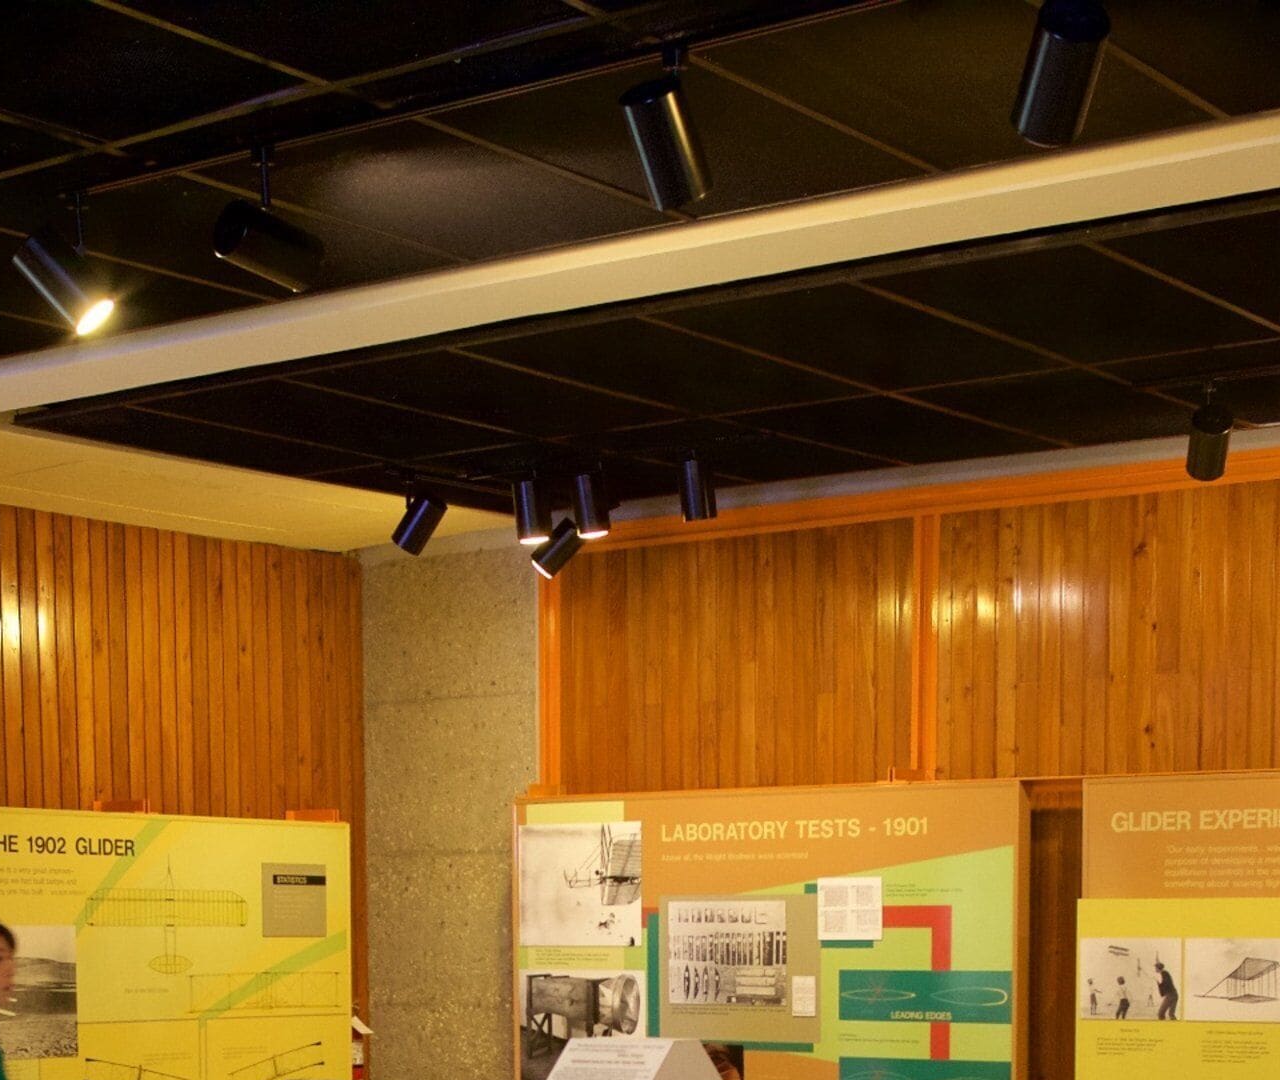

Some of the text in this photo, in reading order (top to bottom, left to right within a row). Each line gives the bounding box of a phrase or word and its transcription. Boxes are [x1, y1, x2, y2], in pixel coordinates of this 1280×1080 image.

[661, 820, 788, 842] LABORATORY
[795, 818, 861, 839] TESTS
[883, 817, 929, 837] 1901
[1111, 809, 1192, 832] GLIDER
[27, 836, 66, 854] 1902
[75, 837, 135, 857] GLIDER
[891, 1010, 953, 1021] LEADING EDGES
